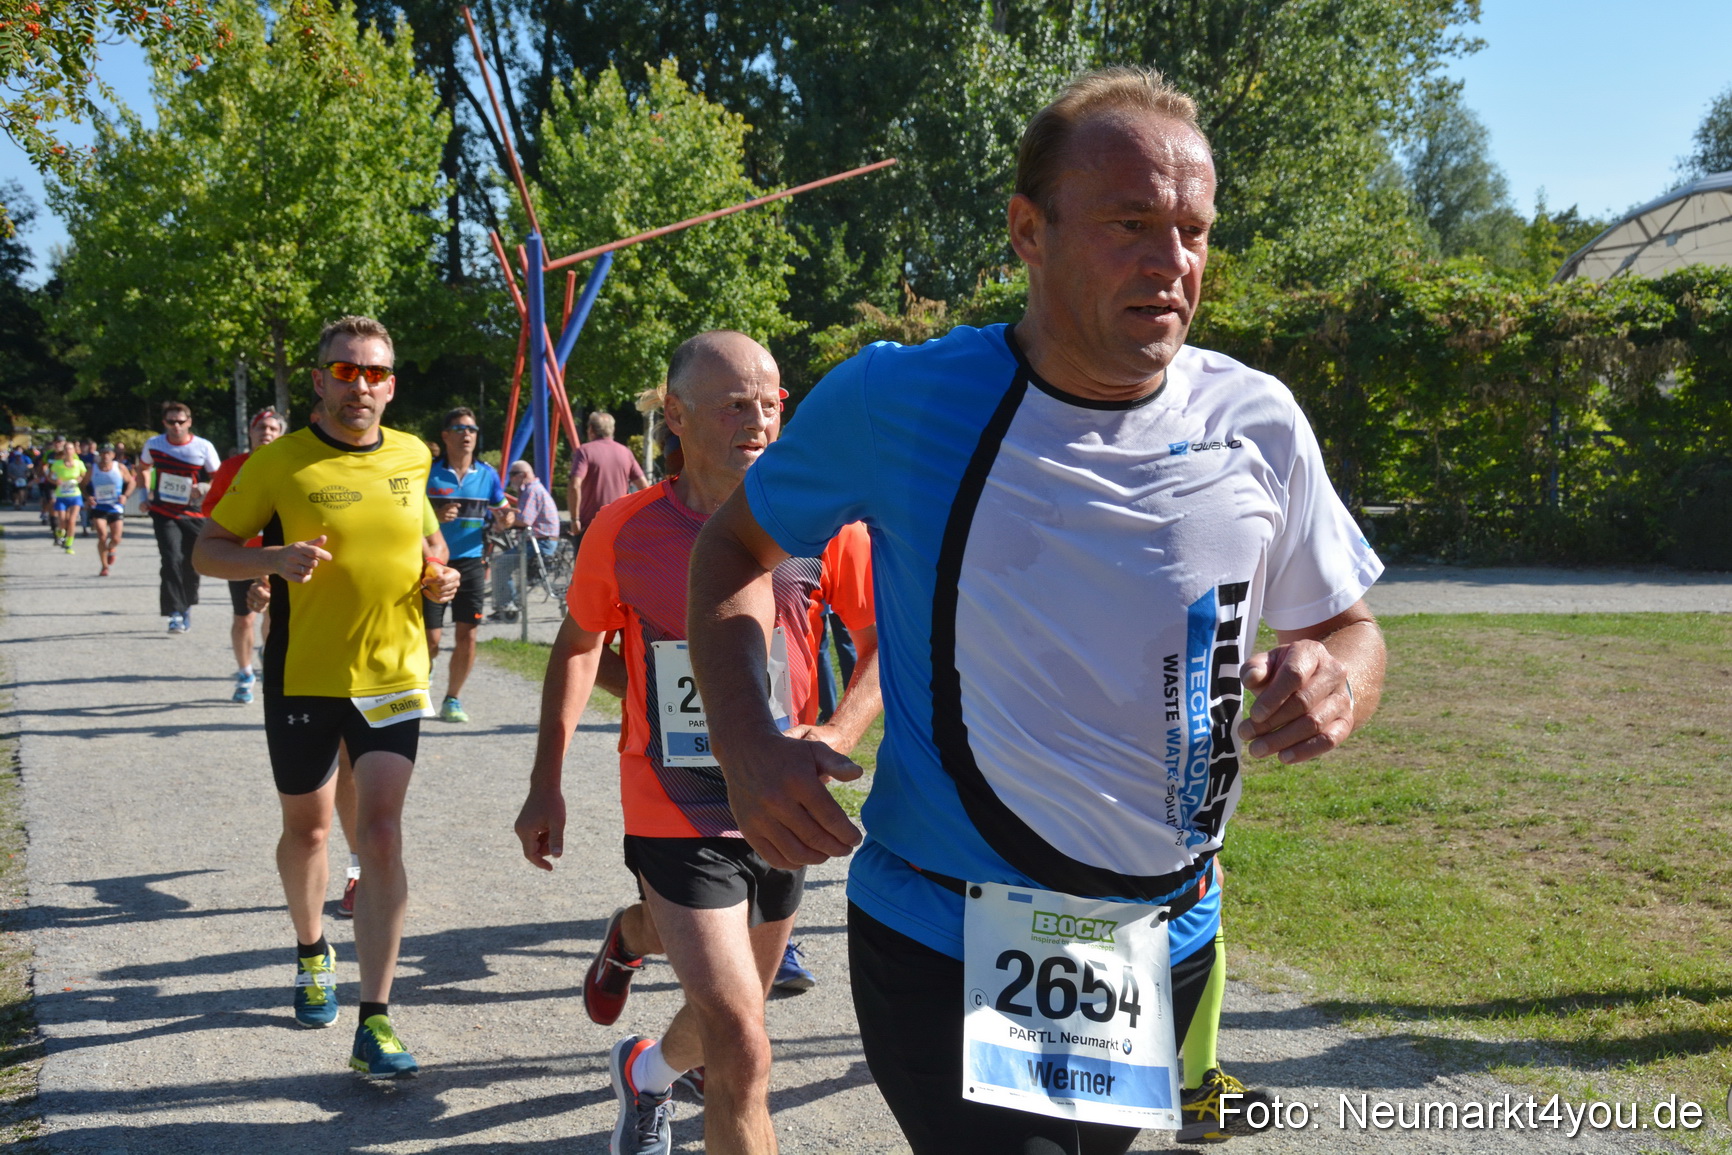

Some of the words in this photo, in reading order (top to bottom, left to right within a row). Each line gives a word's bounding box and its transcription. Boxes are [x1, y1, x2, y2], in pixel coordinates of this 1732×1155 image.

[163, 481, 187, 492] 2519
[1163, 653, 1180, 721] WASTE
[390, 698, 421, 713] Rainer
[667, 705, 673, 713] B
[688, 720, 706, 728] PAR
[694, 736, 710, 753] Si
[1031, 910, 1119, 944] BOCK
[1031, 934, 1061, 945] inspired
[995, 949, 1142, 1029] 2654
[974, 993, 983, 1007] C
[1009, 1026, 1056, 1045] PARTL
[1060, 1032, 1119, 1052] Neumarkt
[1027, 1059, 1116, 1098] Werner
